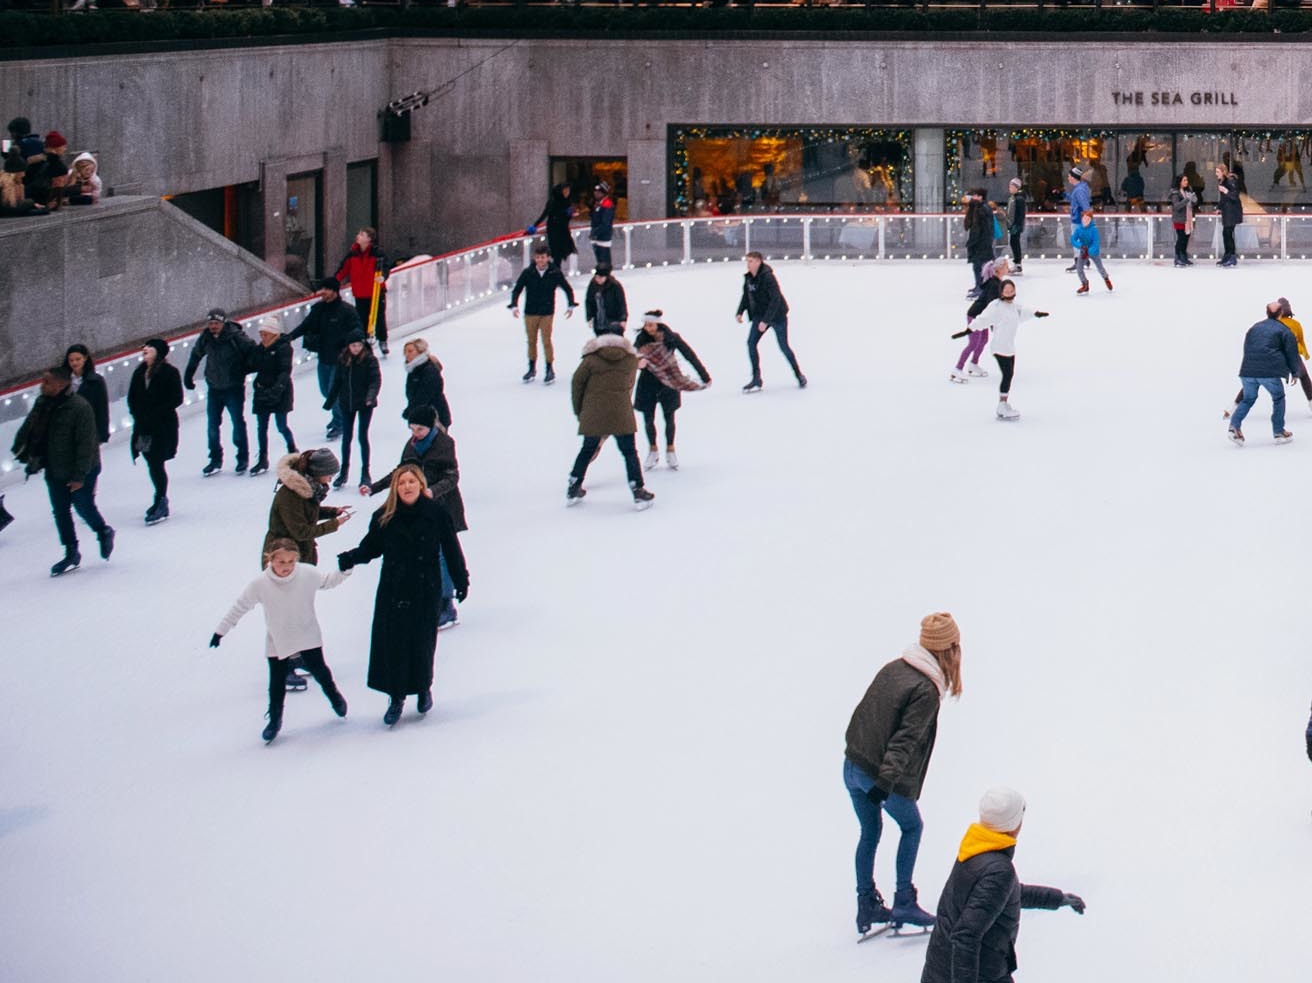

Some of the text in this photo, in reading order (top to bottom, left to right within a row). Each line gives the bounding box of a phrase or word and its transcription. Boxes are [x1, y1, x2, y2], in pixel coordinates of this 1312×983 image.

[1111, 92, 1239, 106] THE SEA GRILL
